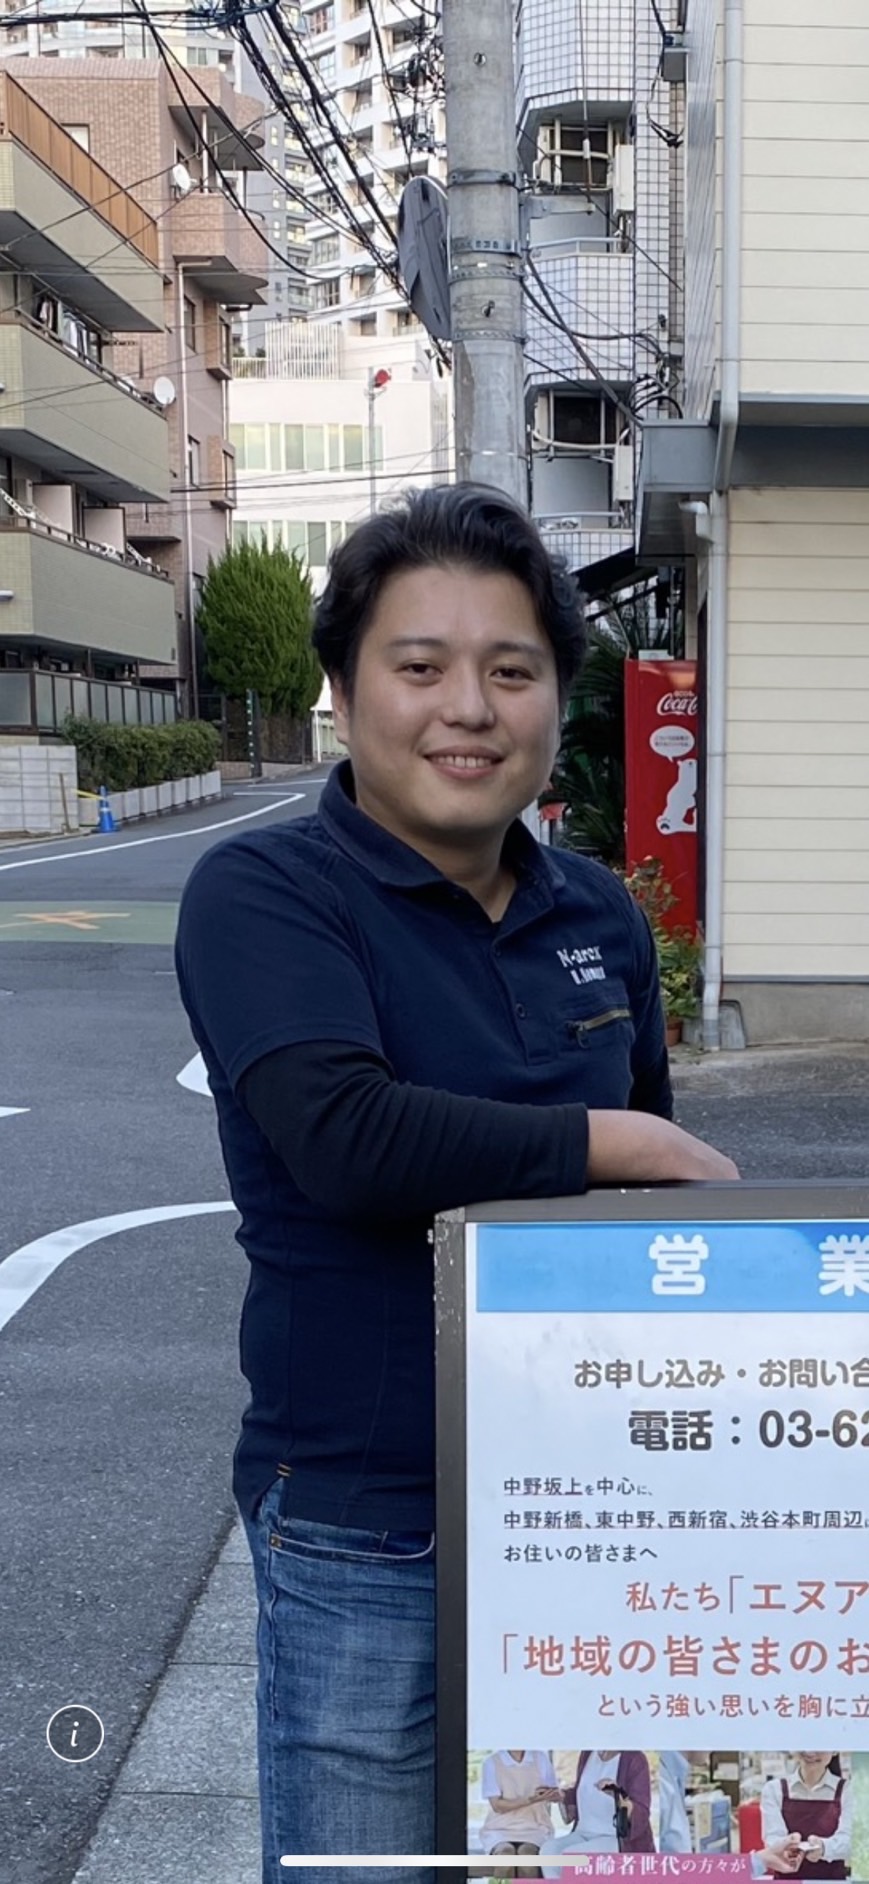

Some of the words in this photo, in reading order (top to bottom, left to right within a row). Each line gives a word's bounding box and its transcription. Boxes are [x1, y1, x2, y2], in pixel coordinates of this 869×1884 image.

[574, 1358, 869, 1389] お申し込み・お問い合
[504, 1544, 658, 1563] お住いの皆さまへ
[625, 1576, 869, 1614] 私たち「エヌア
[503, 1634, 869, 1676] 「地域の皆さまのお
[597, 1694, 869, 1718] という強い思いを胸に立
